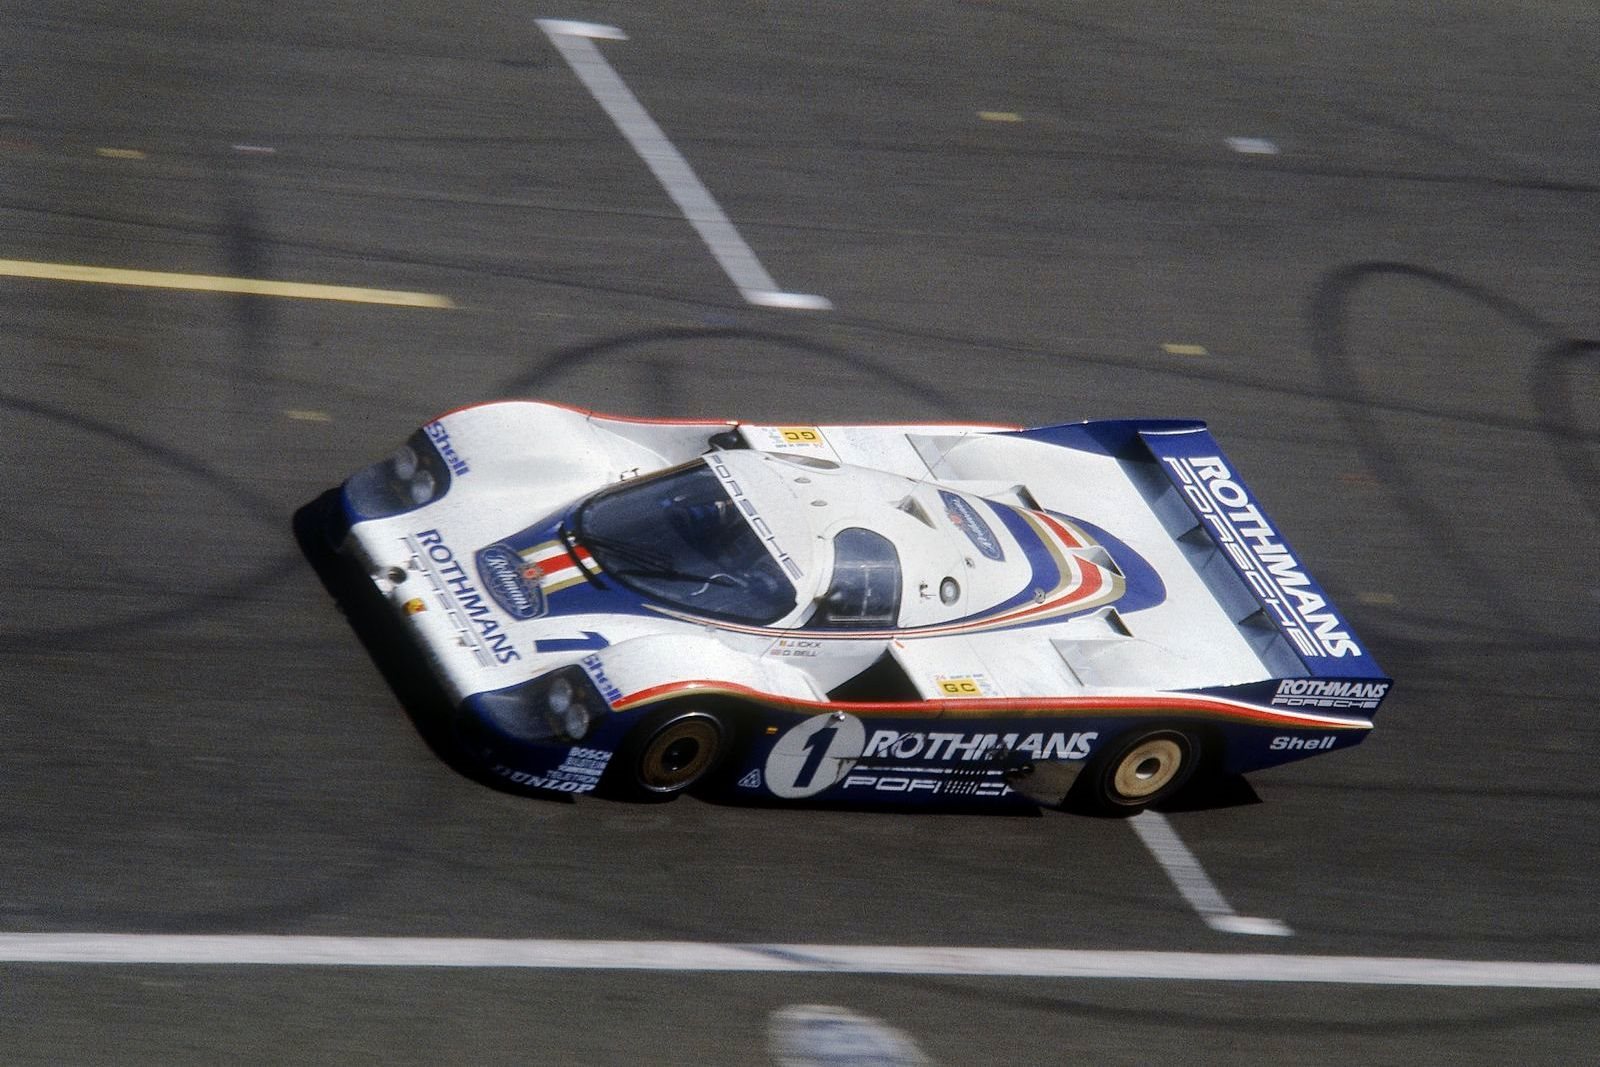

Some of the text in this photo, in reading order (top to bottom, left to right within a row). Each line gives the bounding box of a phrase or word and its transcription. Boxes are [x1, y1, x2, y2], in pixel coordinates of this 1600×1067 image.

[428, 421, 470, 477] Shell
[710, 454, 804, 581] PORSCHE
[1162, 456, 1319, 657] PORSCHE
[1188, 456, 1362, 658] ROTHMANS
[416, 528, 521, 664] ROTHMANS
[943, 683, 976, 693] GC
[1271, 697, 1379, 709] PORSCHE
[1277, 679, 1389, 698] ROTHMANS
[792, 727, 839, 788] 1
[861, 729, 1099, 761] ROTHMANS
[1269, 735, 1337, 750] Shell
